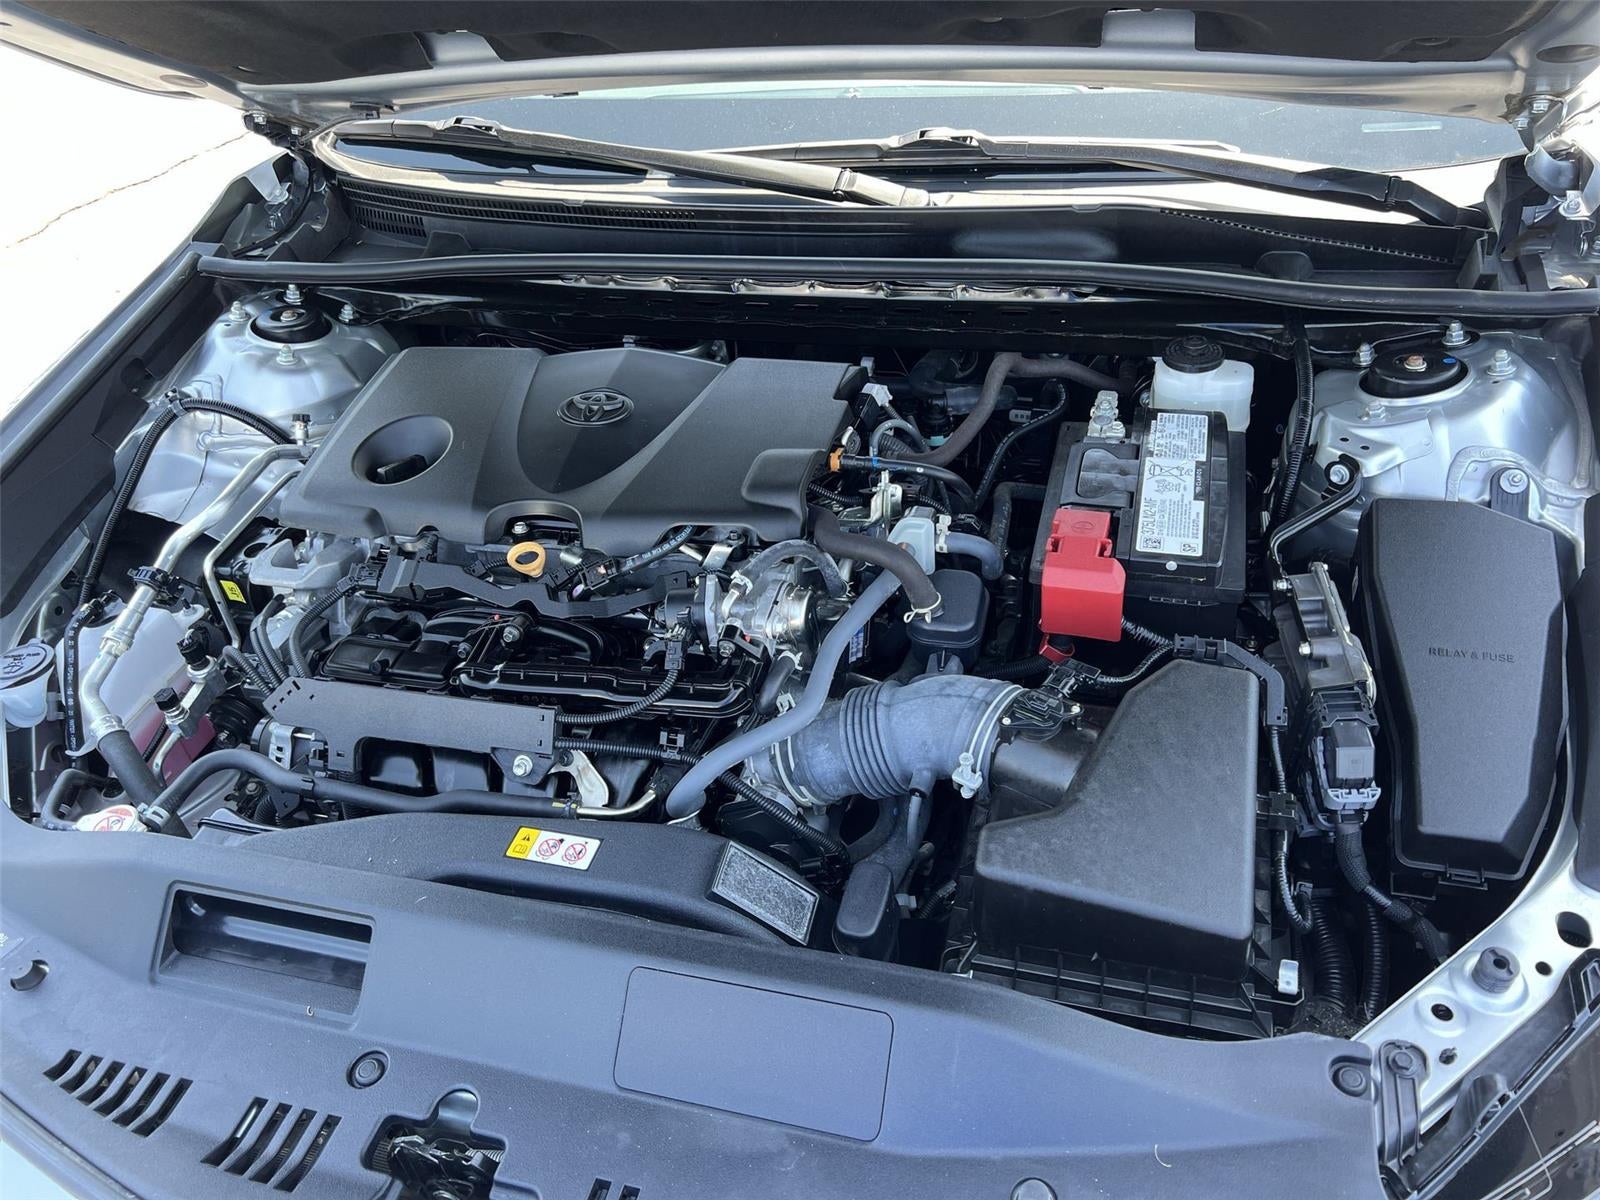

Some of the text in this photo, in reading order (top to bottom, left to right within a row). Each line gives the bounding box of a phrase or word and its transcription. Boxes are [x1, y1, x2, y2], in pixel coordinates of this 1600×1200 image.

[1428, 647, 1515, 663] RELAY & FUSE
